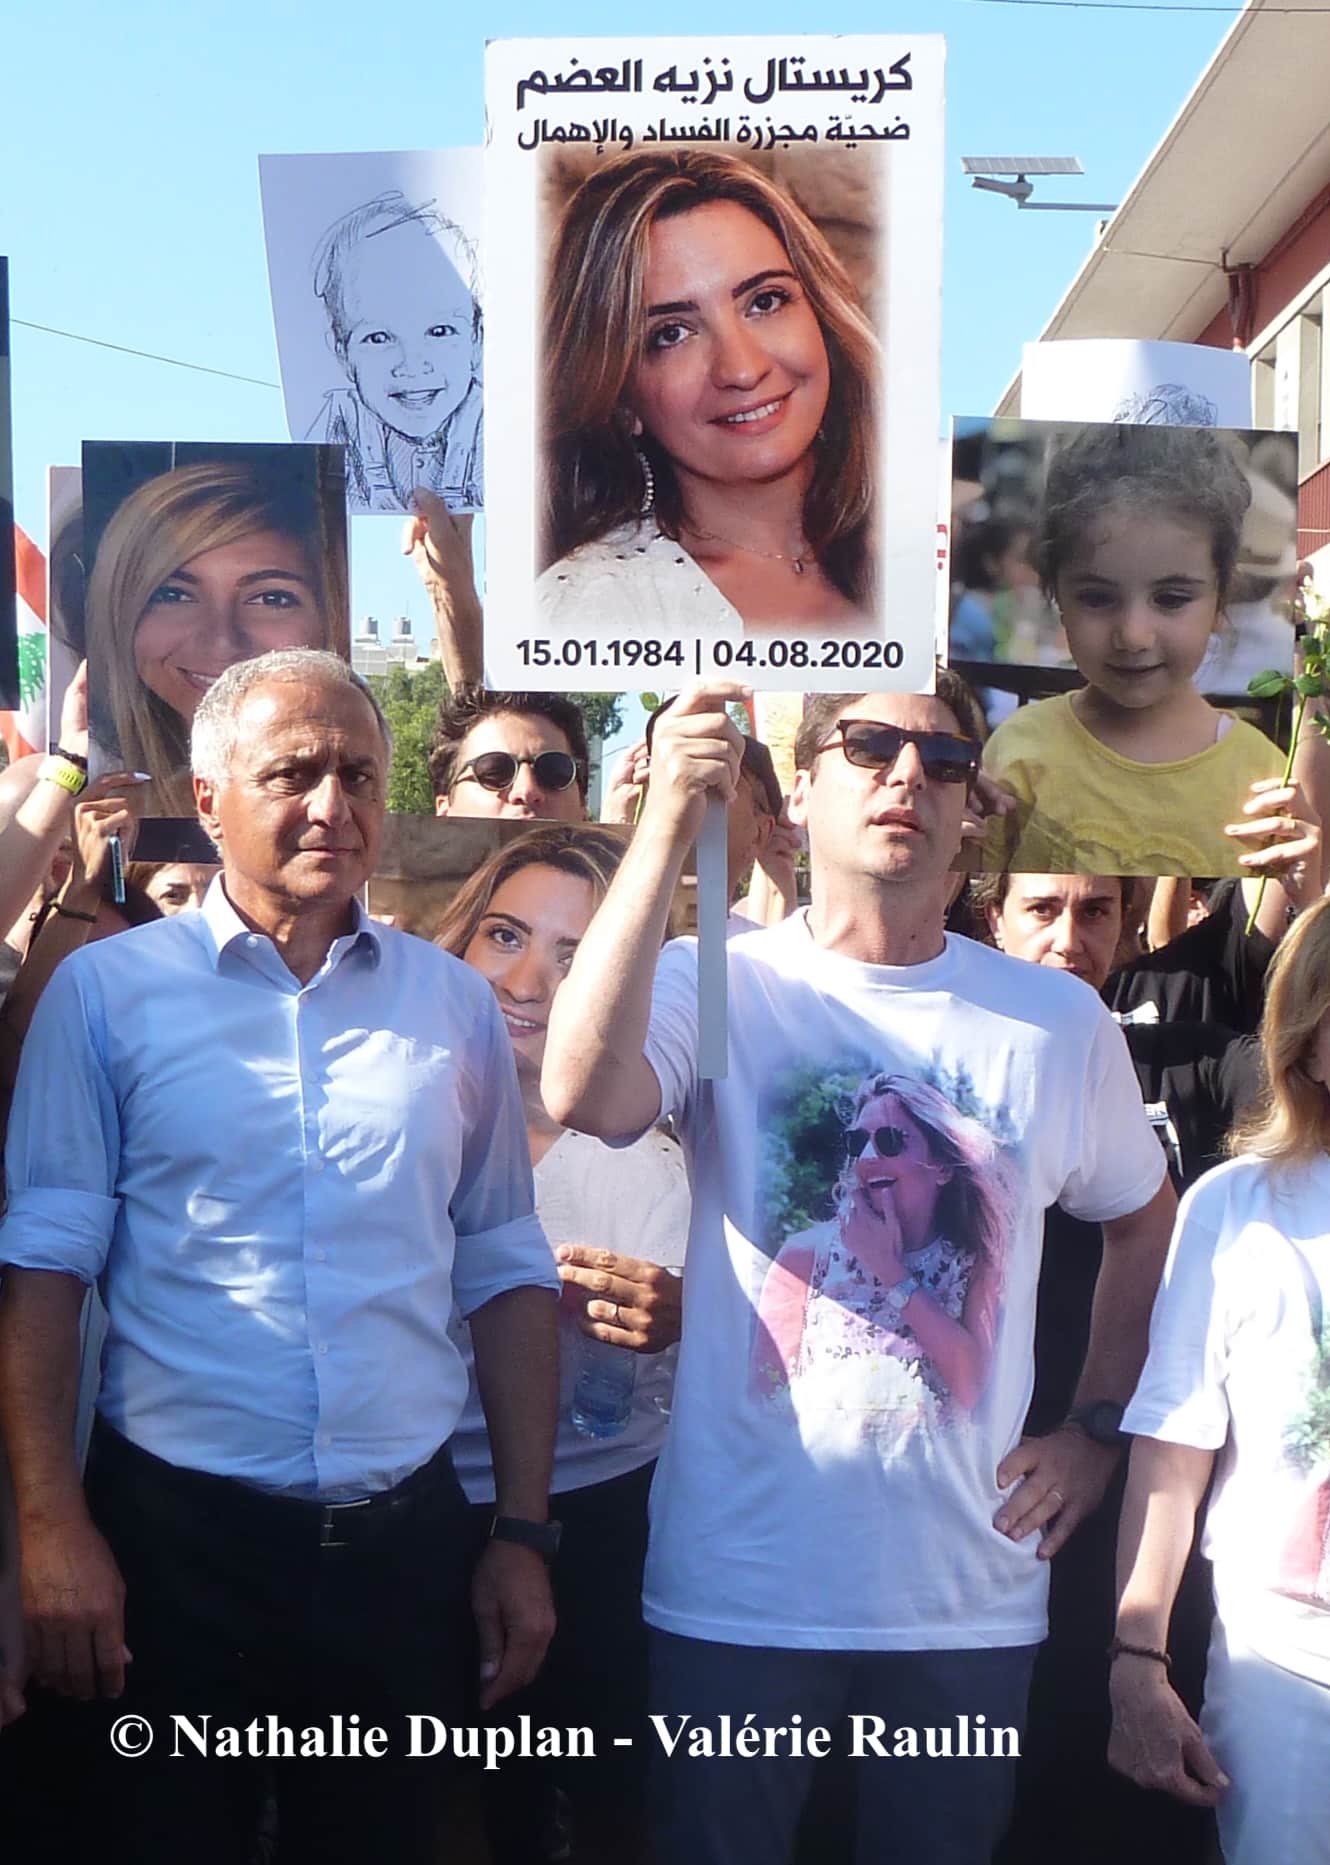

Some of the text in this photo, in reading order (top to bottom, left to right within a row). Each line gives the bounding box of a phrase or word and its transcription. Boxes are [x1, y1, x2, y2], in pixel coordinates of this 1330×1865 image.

[516, 52, 913, 111] كريستال نزيه العضم
[517, 117, 635, 156] والإهمال
[642, 116, 730, 142] الفساد
[736, 115, 818, 150] مجزرة
[516, 639, 685, 667] 15.01.1984
[712, 639, 904, 669] 04.08.2020
